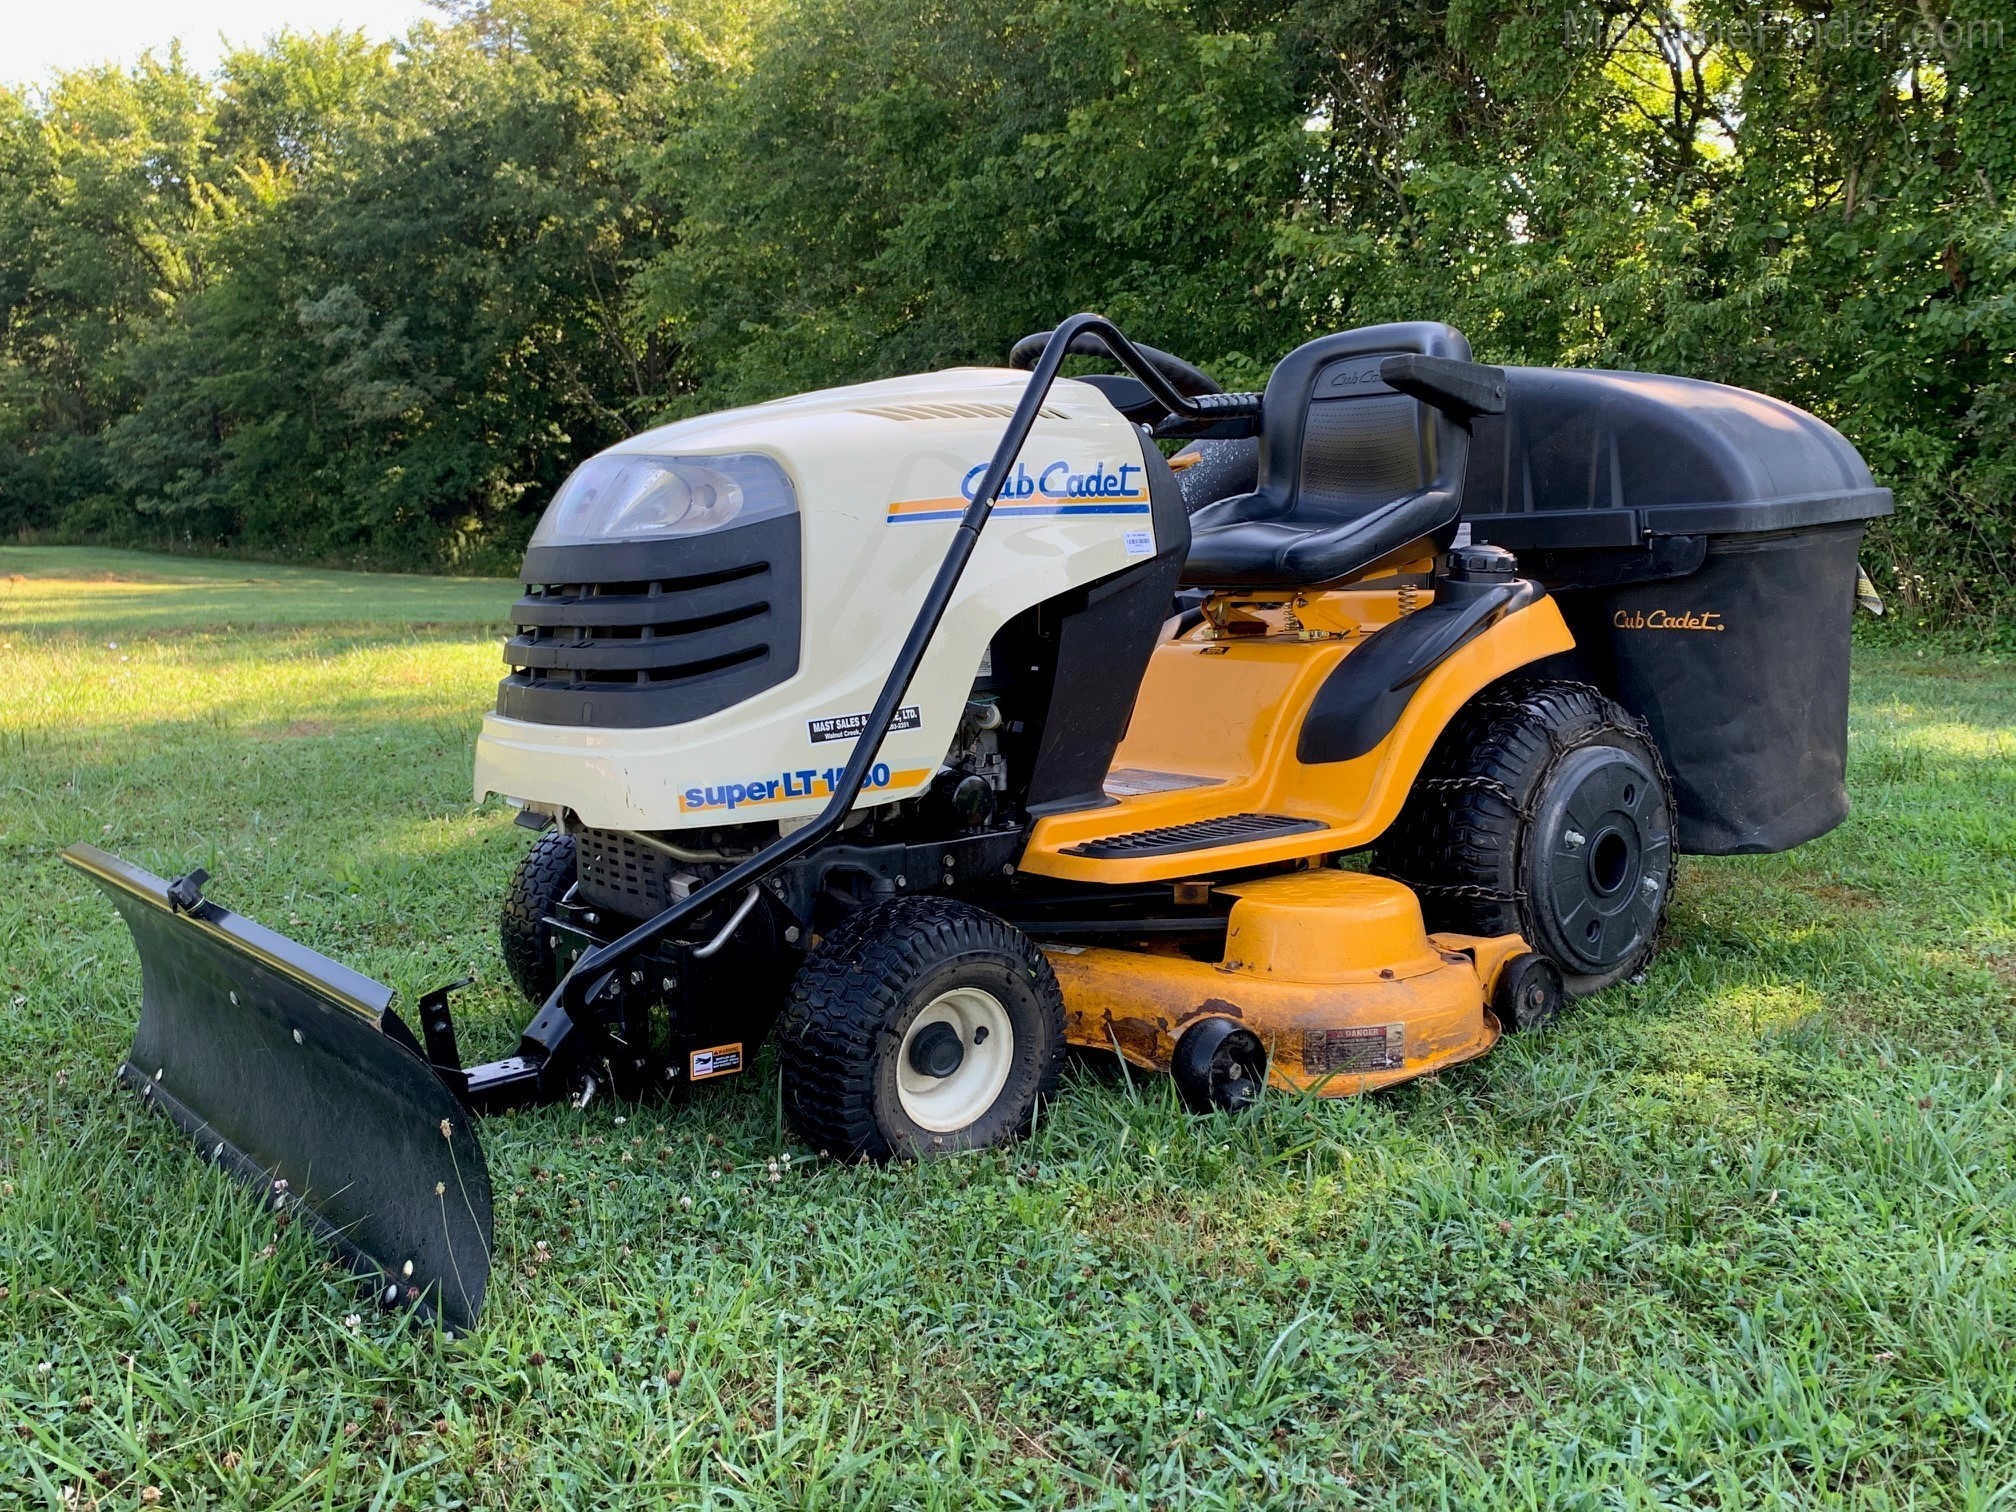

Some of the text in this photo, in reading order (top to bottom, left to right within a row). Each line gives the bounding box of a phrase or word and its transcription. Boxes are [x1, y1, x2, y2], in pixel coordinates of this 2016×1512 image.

[1039, 461, 1142, 499] Cadet
[1613, 610, 1645, 629] Cub
[813, 721, 835, 733] MAST
[836, 716, 860, 730] SALES
[861, 716, 868, 726] &
[902, 709, 918, 720] LTD.
[1345, 1028, 1379, 1038] DANGER
